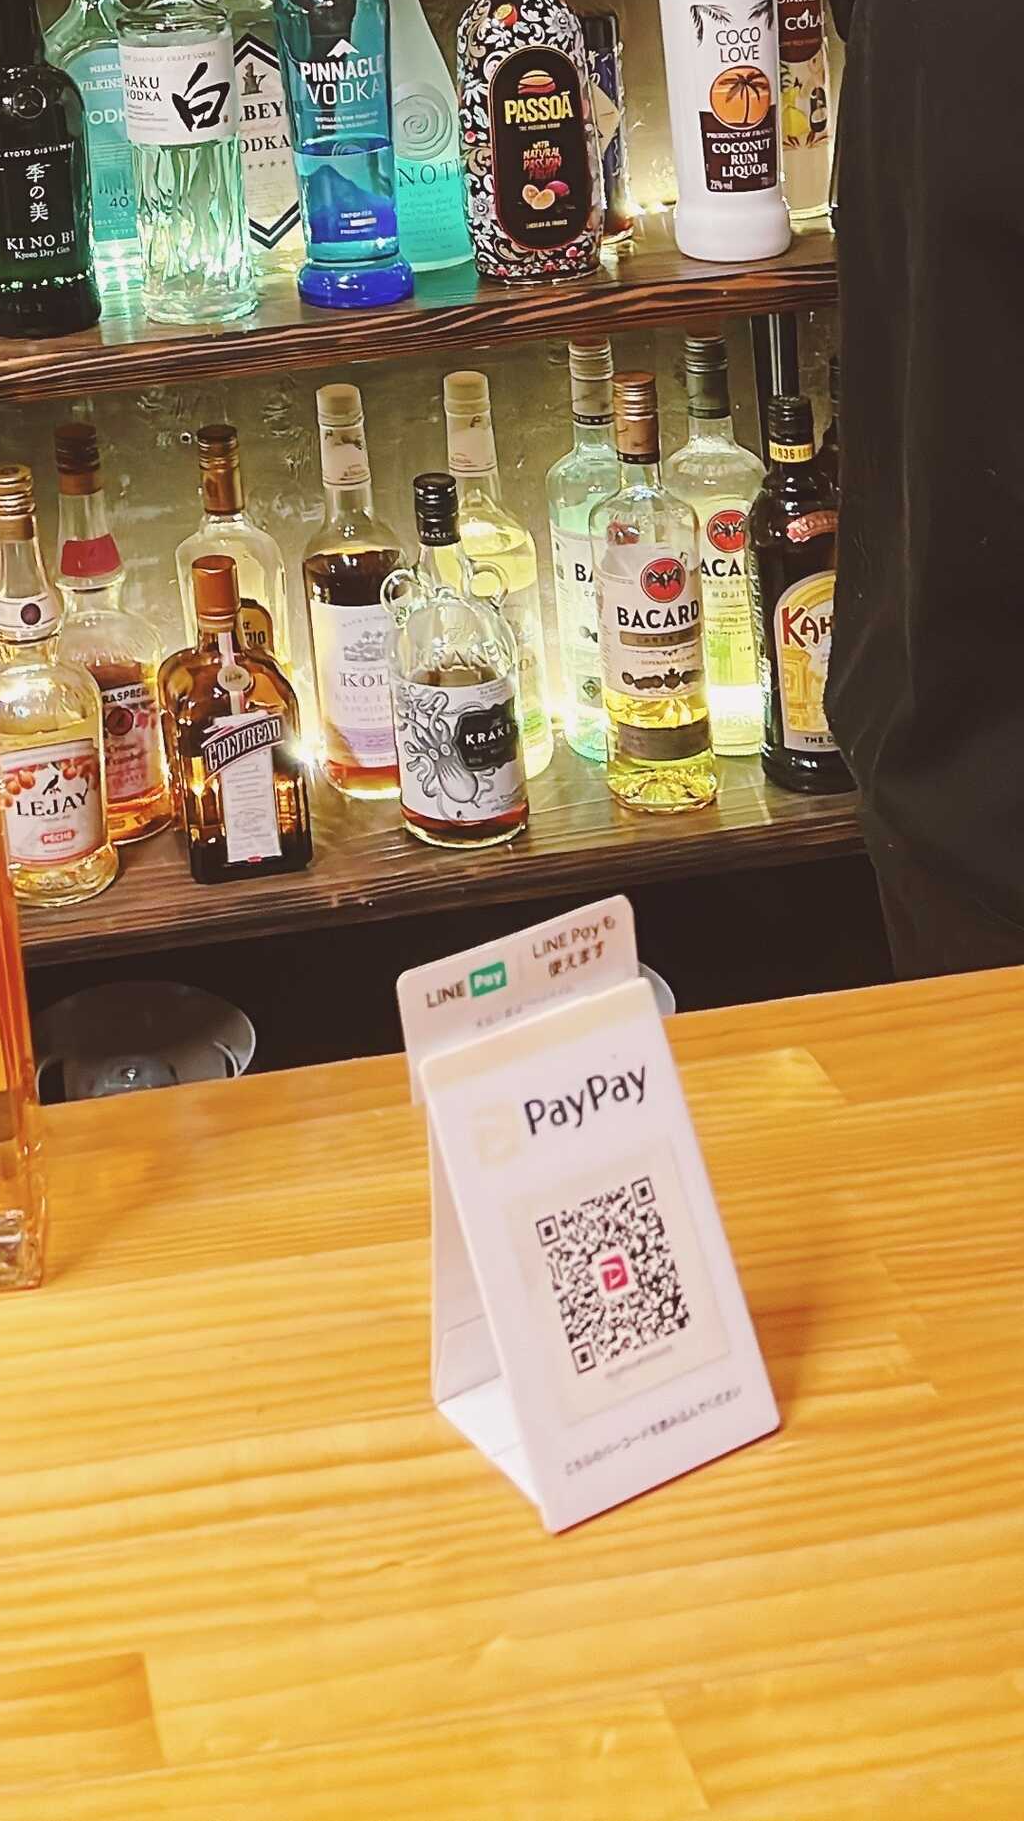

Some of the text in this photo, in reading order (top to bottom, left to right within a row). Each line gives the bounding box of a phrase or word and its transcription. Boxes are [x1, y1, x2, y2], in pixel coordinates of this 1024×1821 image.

[716, 26, 761, 46] COCO
[720, 44, 761, 63] LOVE
[124, 75, 160, 90] HAKU
[306, 80, 381, 107] VODKA
[171, 61, 231, 133] 白
[504, 90, 573, 125] PASSOÃ
[240, 100, 285, 123] BEY
[706, 131, 741, 139] PRODUCT
[711, 137, 771, 154] COCONUT
[523, 146, 560, 161] NATURAL
[730, 153, 759, 166] RUM
[397, 157, 462, 189] NOTI
[721, 163, 769, 179] LIQUOR
[25, 162, 51, 223] 季の美
[6, 230, 75, 251] KI NO BI
[39, 248, 55, 258] Dry
[701, 557, 745, 578] ACA
[711, 590, 746, 599] MOJIT
[617, 599, 701, 630] BACARD
[782, 606, 833, 648] KAH
[339, 671, 387, 688] KOL
[207, 717, 281, 774] COINTREAU
[16, 787, 89, 817] LEJAY
[531, 932, 568, 960] LINE
[570, 921, 600, 945] Pay
[546, 940, 606, 980] 使えます
[425, 979, 467, 1009] LINE
[473, 969, 504, 991] Pay
[523, 1064, 648, 1136] PayPay
